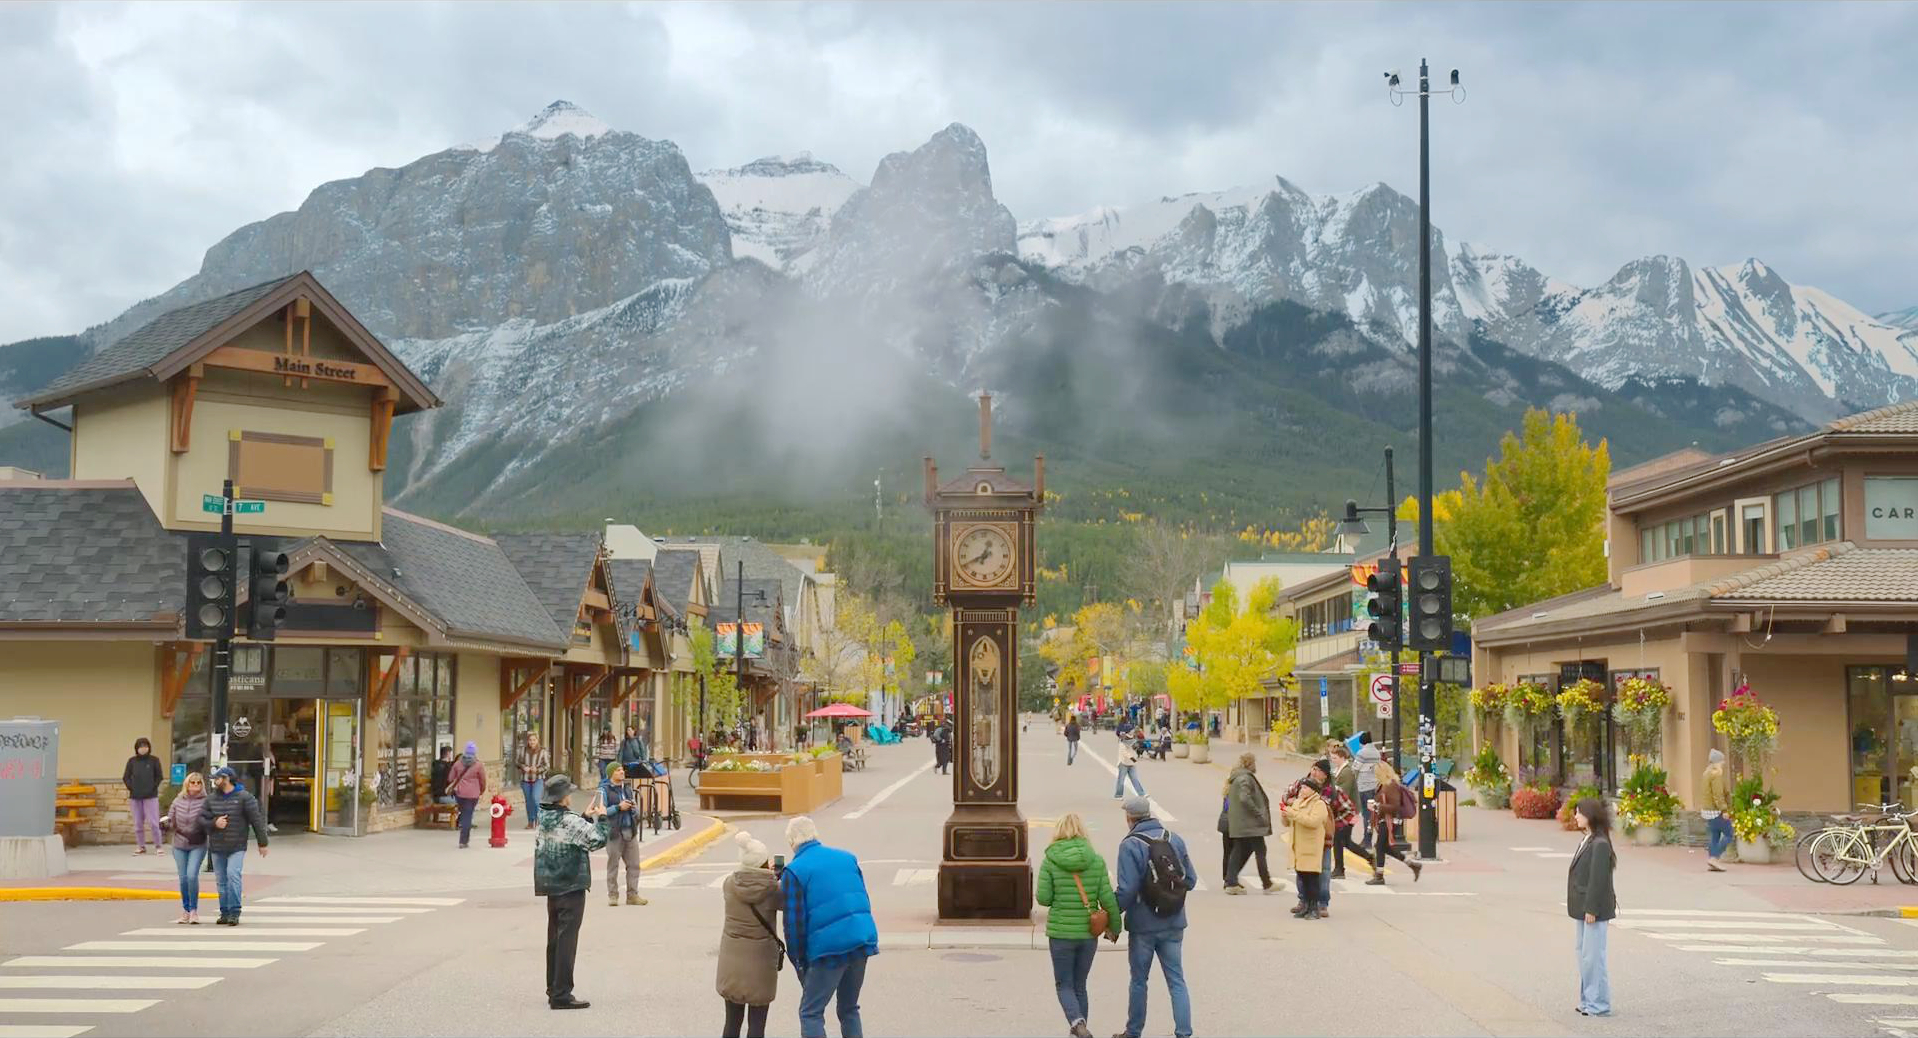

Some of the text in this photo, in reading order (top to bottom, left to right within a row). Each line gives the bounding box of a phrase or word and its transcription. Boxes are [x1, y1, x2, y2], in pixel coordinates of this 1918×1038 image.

[274, 357, 356, 379] Main Street
[238, 503, 243, 512] 7
[1872, 507, 1914, 519] CAR
